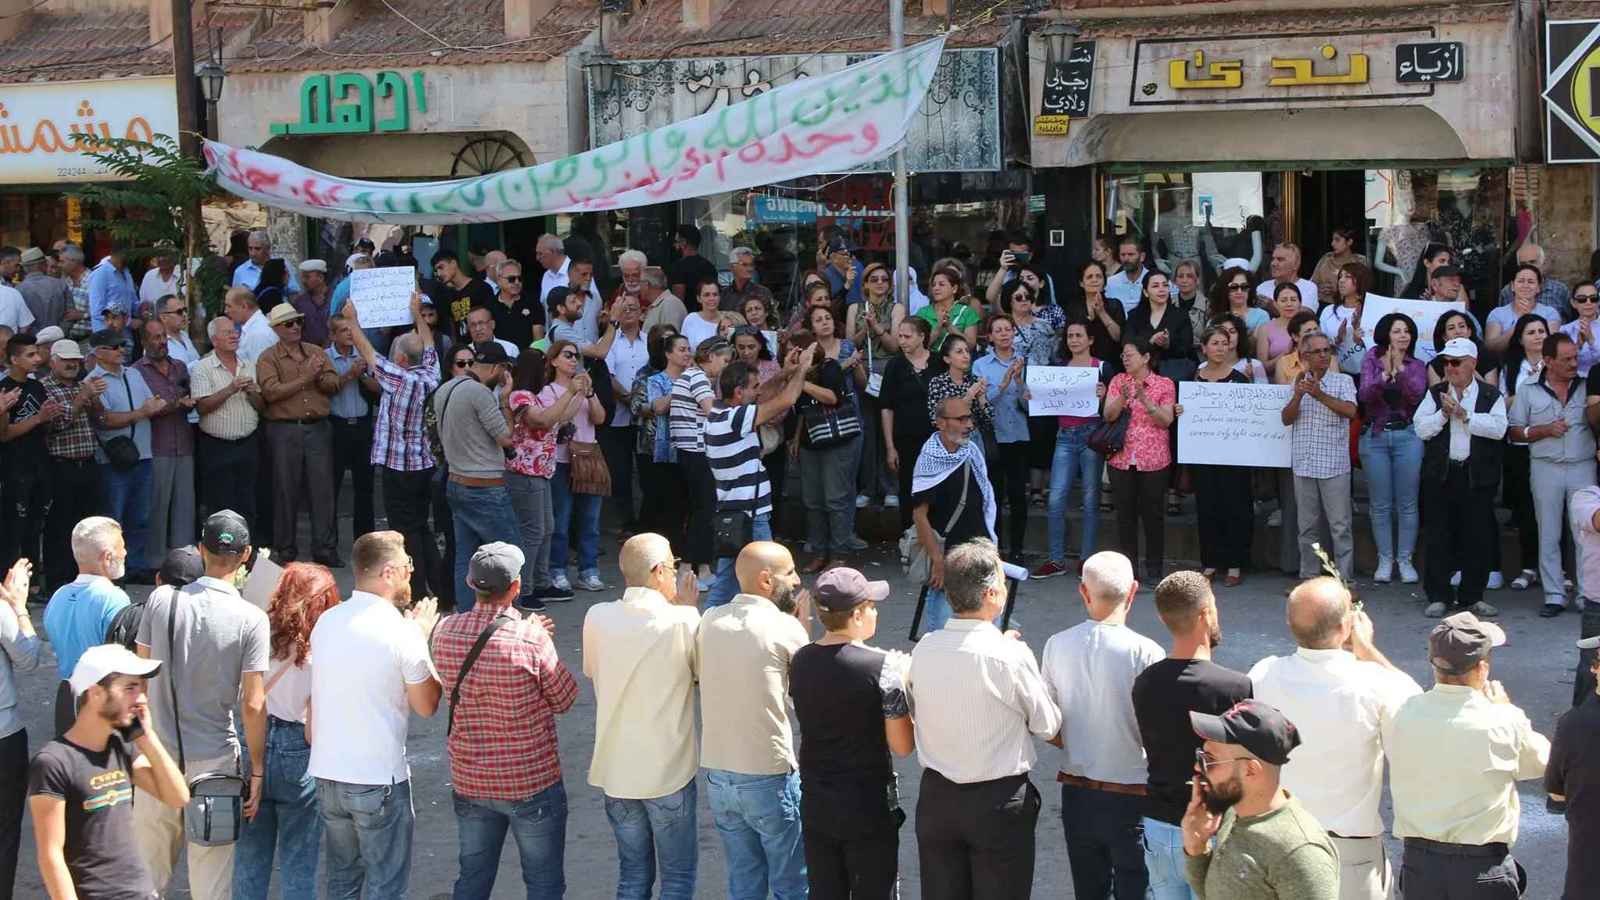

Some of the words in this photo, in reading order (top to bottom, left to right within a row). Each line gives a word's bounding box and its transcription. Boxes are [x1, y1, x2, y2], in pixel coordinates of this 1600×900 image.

[1399, 42, 1460, 82] أزياء
[1045, 68, 1089, 90] رجالي
[1044, 93, 1086, 113] ولادي
